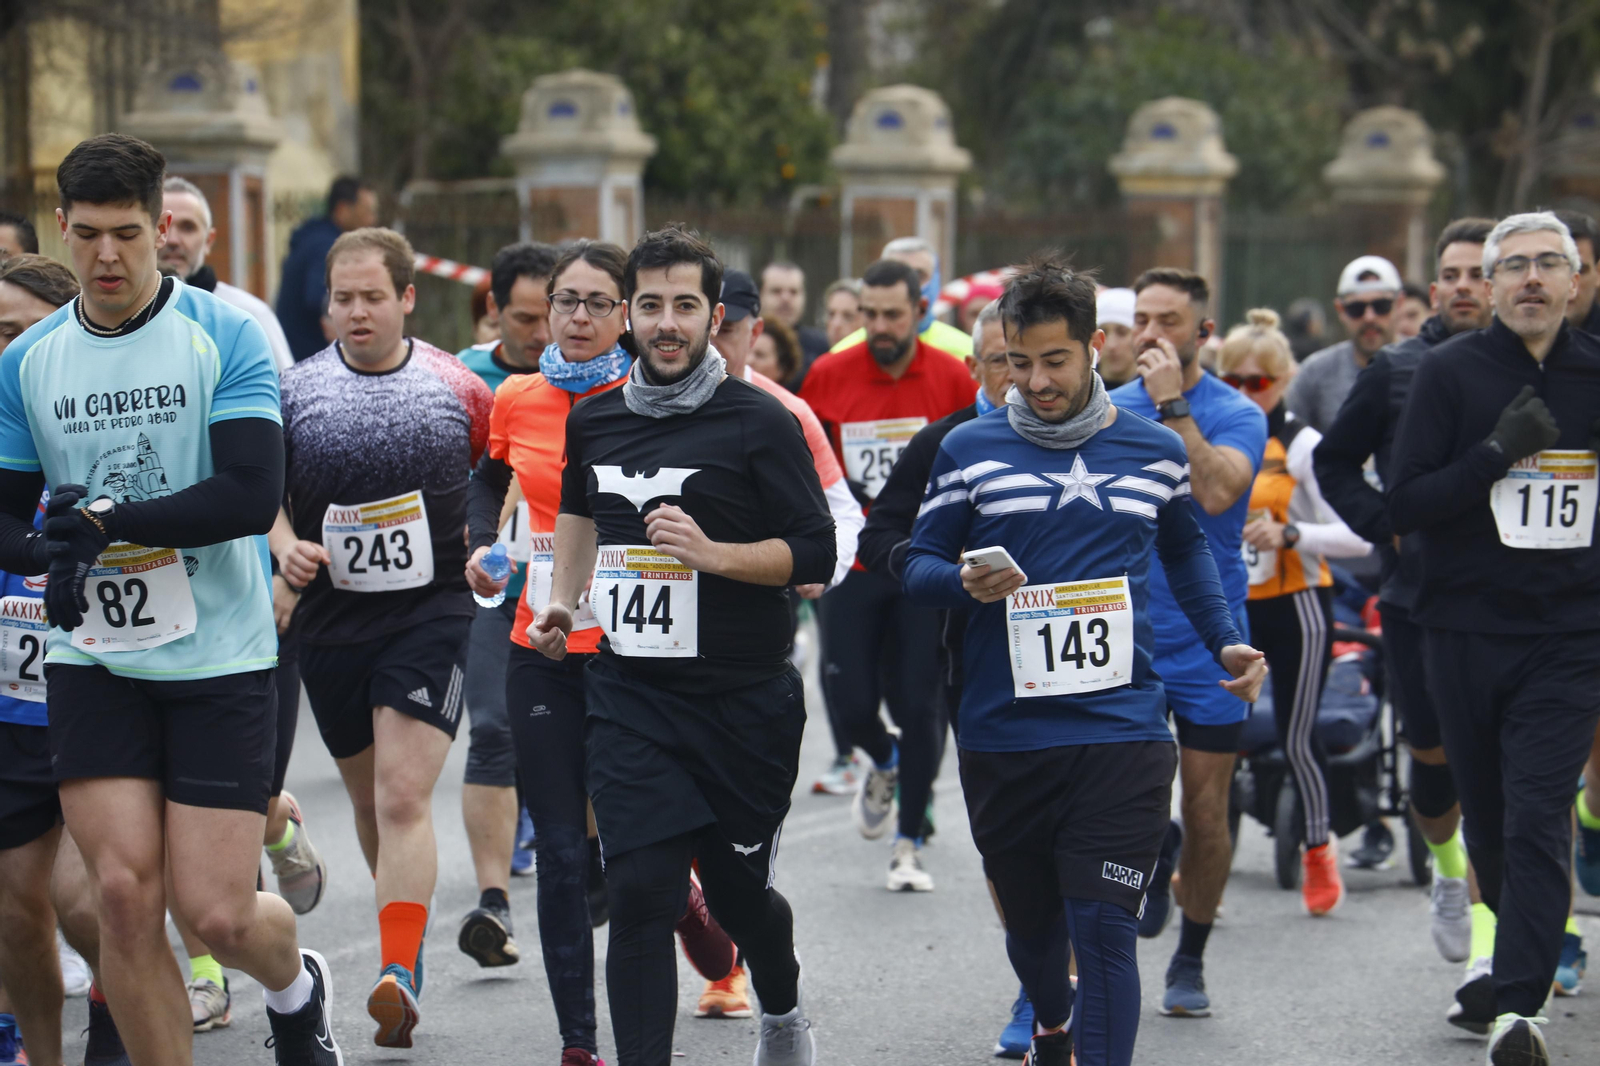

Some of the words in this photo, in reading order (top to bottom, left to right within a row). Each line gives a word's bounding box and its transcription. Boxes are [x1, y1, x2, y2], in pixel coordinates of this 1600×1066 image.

[54, 395, 76, 420] VII
[85, 384, 186, 417] CARRERA
[94, 419, 107, 431] DE
[110, 415, 143, 430] PEDRO
[148, 411, 177, 424] ABAD
[1518, 484, 1579, 528] 115
[101, 551, 128, 559] SANTISIMA
[128, 547, 154, 557] TRINIDAD
[153, 548, 174, 557] RIVERA
[344, 529, 413, 574] 243
[598, 550, 626, 568] XXXIX
[95, 567, 119, 575] Trinidad
[122, 556, 178, 573] TRINITARIOS
[620, 571, 638, 579] Trinidad
[642, 571, 693, 580] TRINITARIOS
[96, 578, 156, 629] 82
[1011, 589, 1055, 609] XXXIX
[1055, 585, 1080, 593] CARRERA
[1080, 583, 1101, 591] POPULAR
[1055, 592, 1083, 600] SANTISIMA
[2, 600, 42, 620] XXXIX
[608, 584, 673, 634] 144
[1011, 612, 1031, 621] Colegio
[1048, 608, 1071, 617] Trinidad
[1076, 603, 1128, 614] TRINITARIOS
[1037, 617, 1110, 672] 143
[1103, 862, 1141, 889] MARVEL
